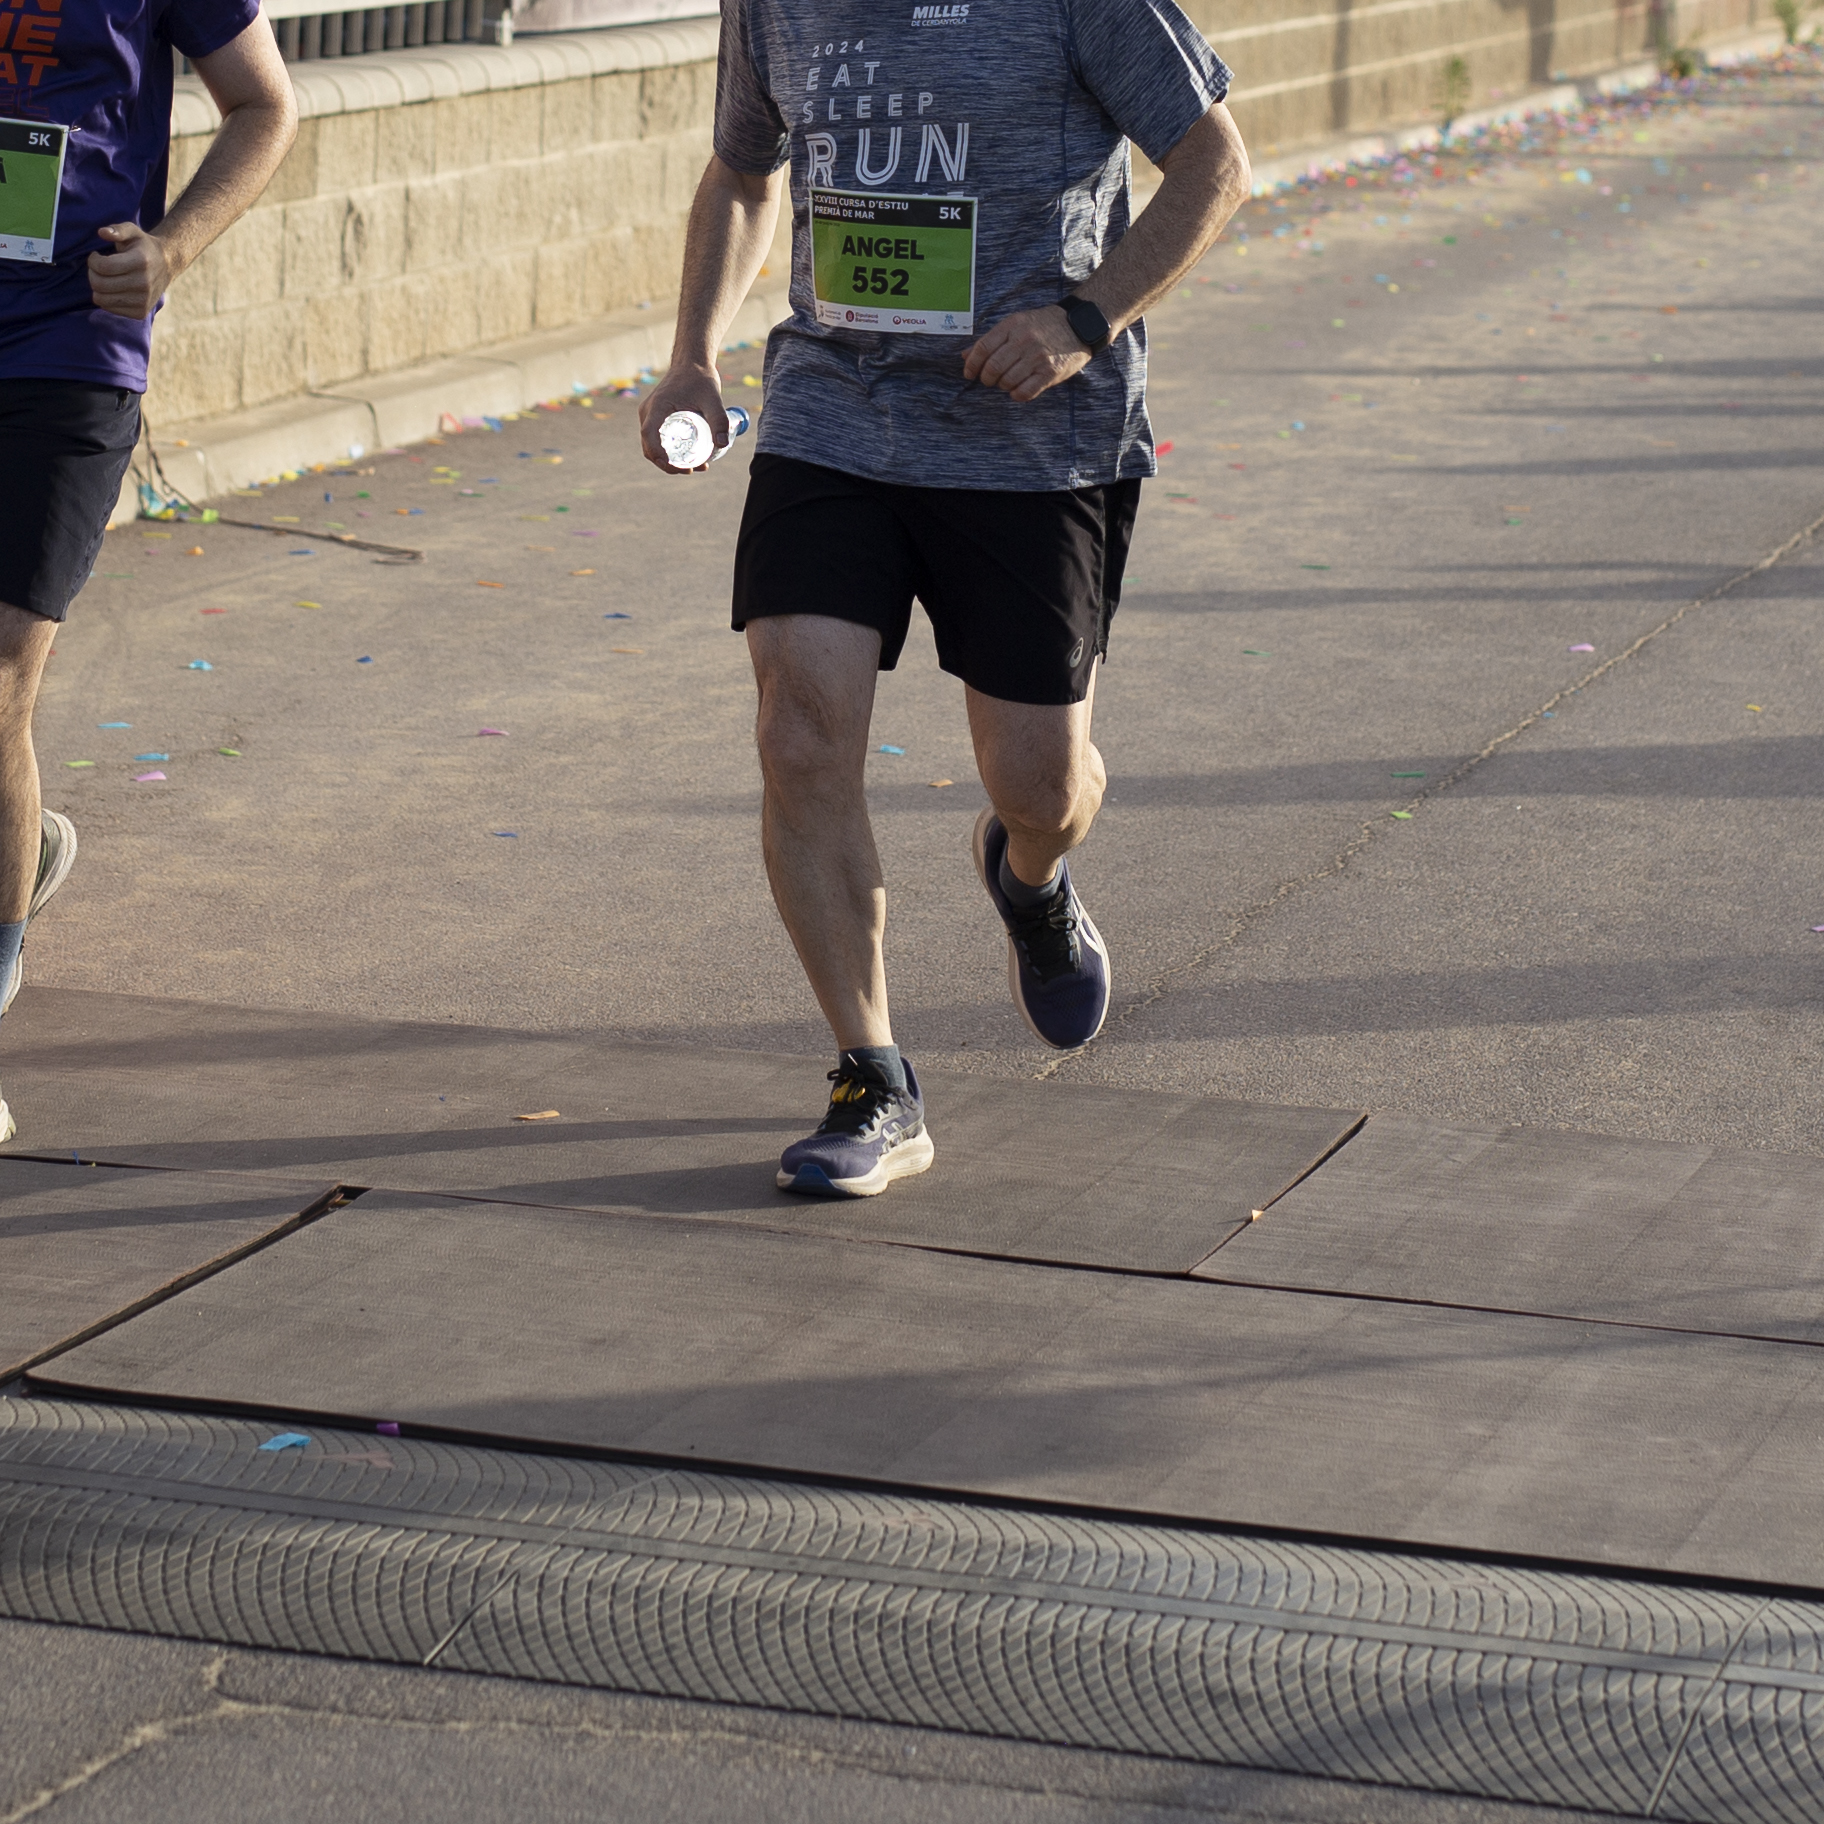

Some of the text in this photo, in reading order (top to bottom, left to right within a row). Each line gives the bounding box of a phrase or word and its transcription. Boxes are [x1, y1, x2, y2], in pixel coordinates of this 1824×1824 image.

[912, 4, 970, 19] MILLES
[812, 40, 864, 58] 2024
[806, 61, 881, 91] EAT
[802, 92, 934, 124] SLEEP
[28, 132, 52, 147] 5K
[804, 123, 970, 187] RUN
[814, 206, 875, 219] PREMIÀ DE MAR
[839, 197, 866, 208] CURSA
[869, 200, 909, 210] D'ESTIU
[938, 206, 962, 220] 5K
[842, 235, 925, 260] ANGEL
[852, 266, 910, 296] 552
